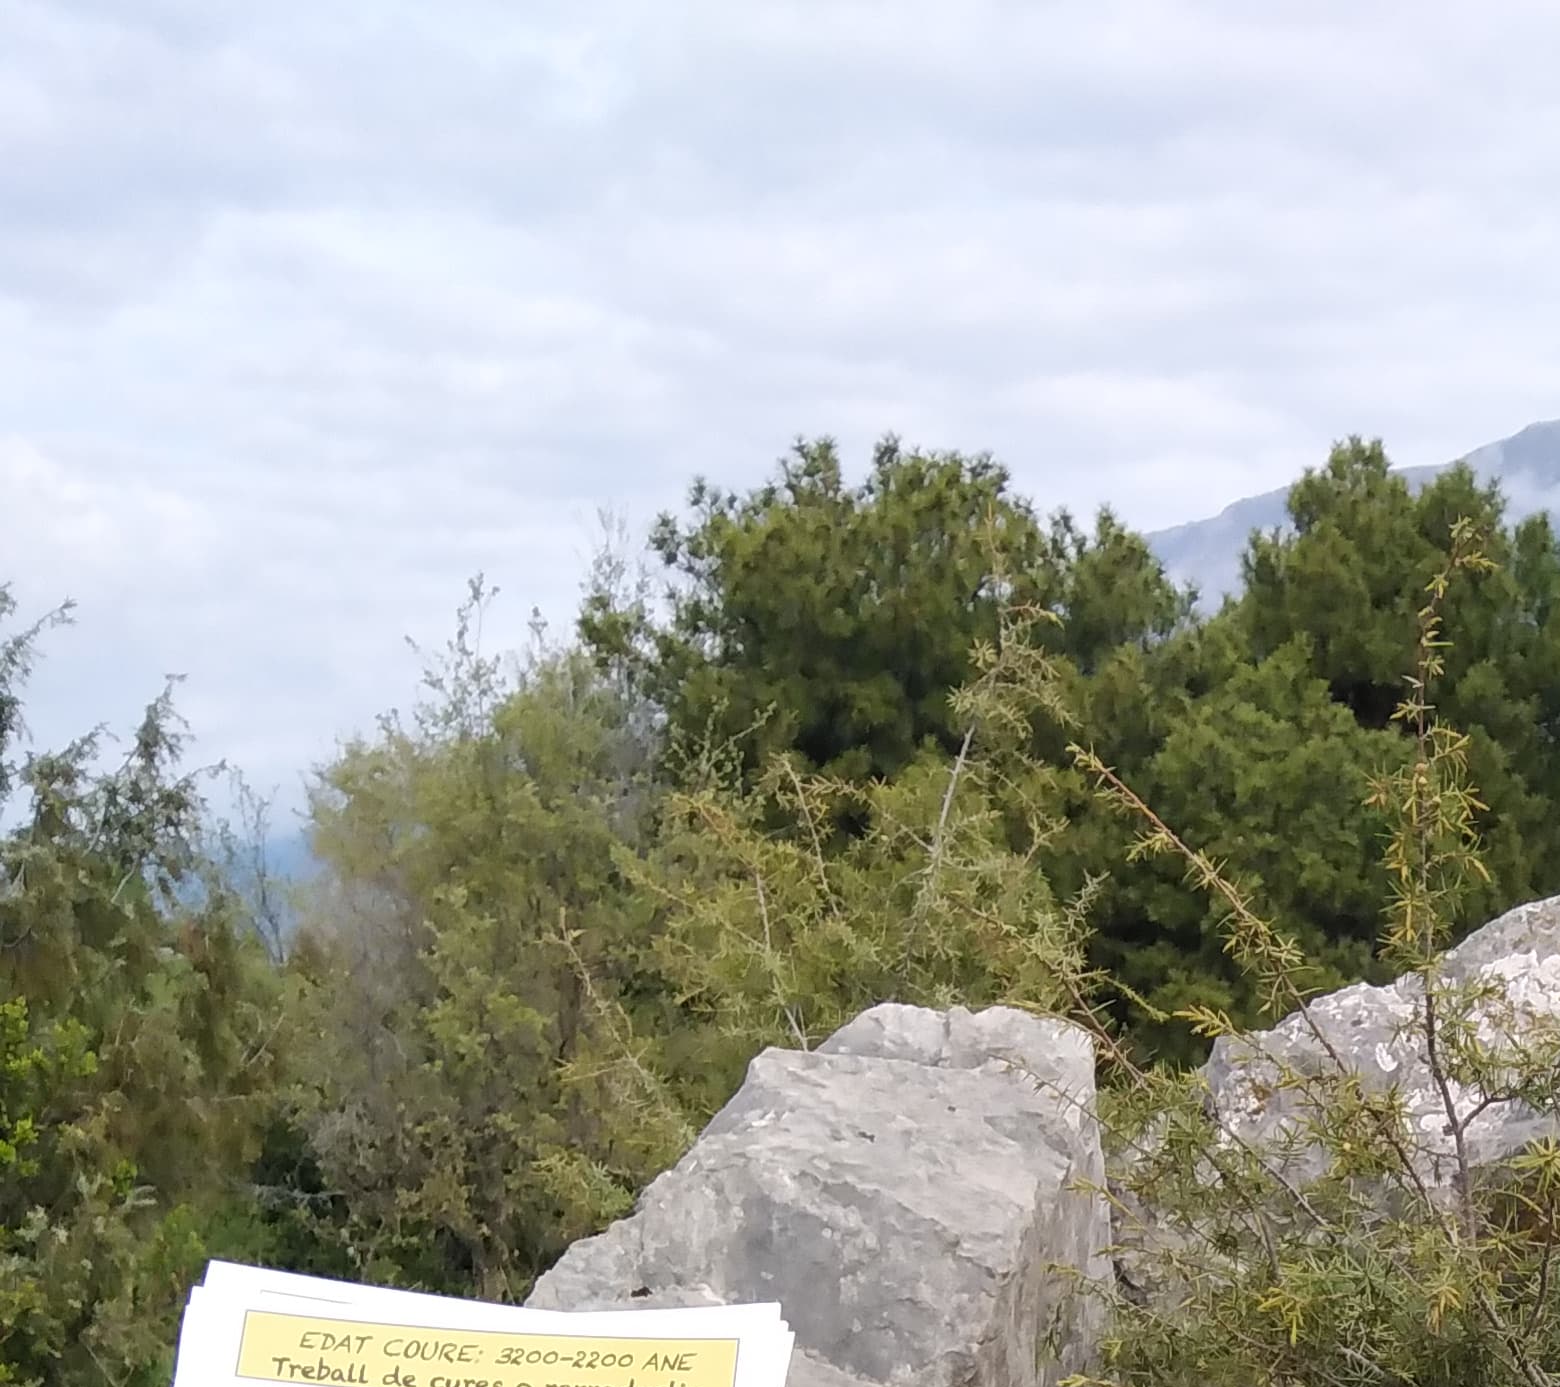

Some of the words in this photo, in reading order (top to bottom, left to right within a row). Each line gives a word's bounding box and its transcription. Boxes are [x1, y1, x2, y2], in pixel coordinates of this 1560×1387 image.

[299, 1331, 374, 1355] EDAT
[383, 1339, 484, 1364] COURE:
[494, 1347, 634, 1369] 3200-2200
[641, 1352, 698, 1371] ANE
[272, 1357, 369, 1384] Treball
